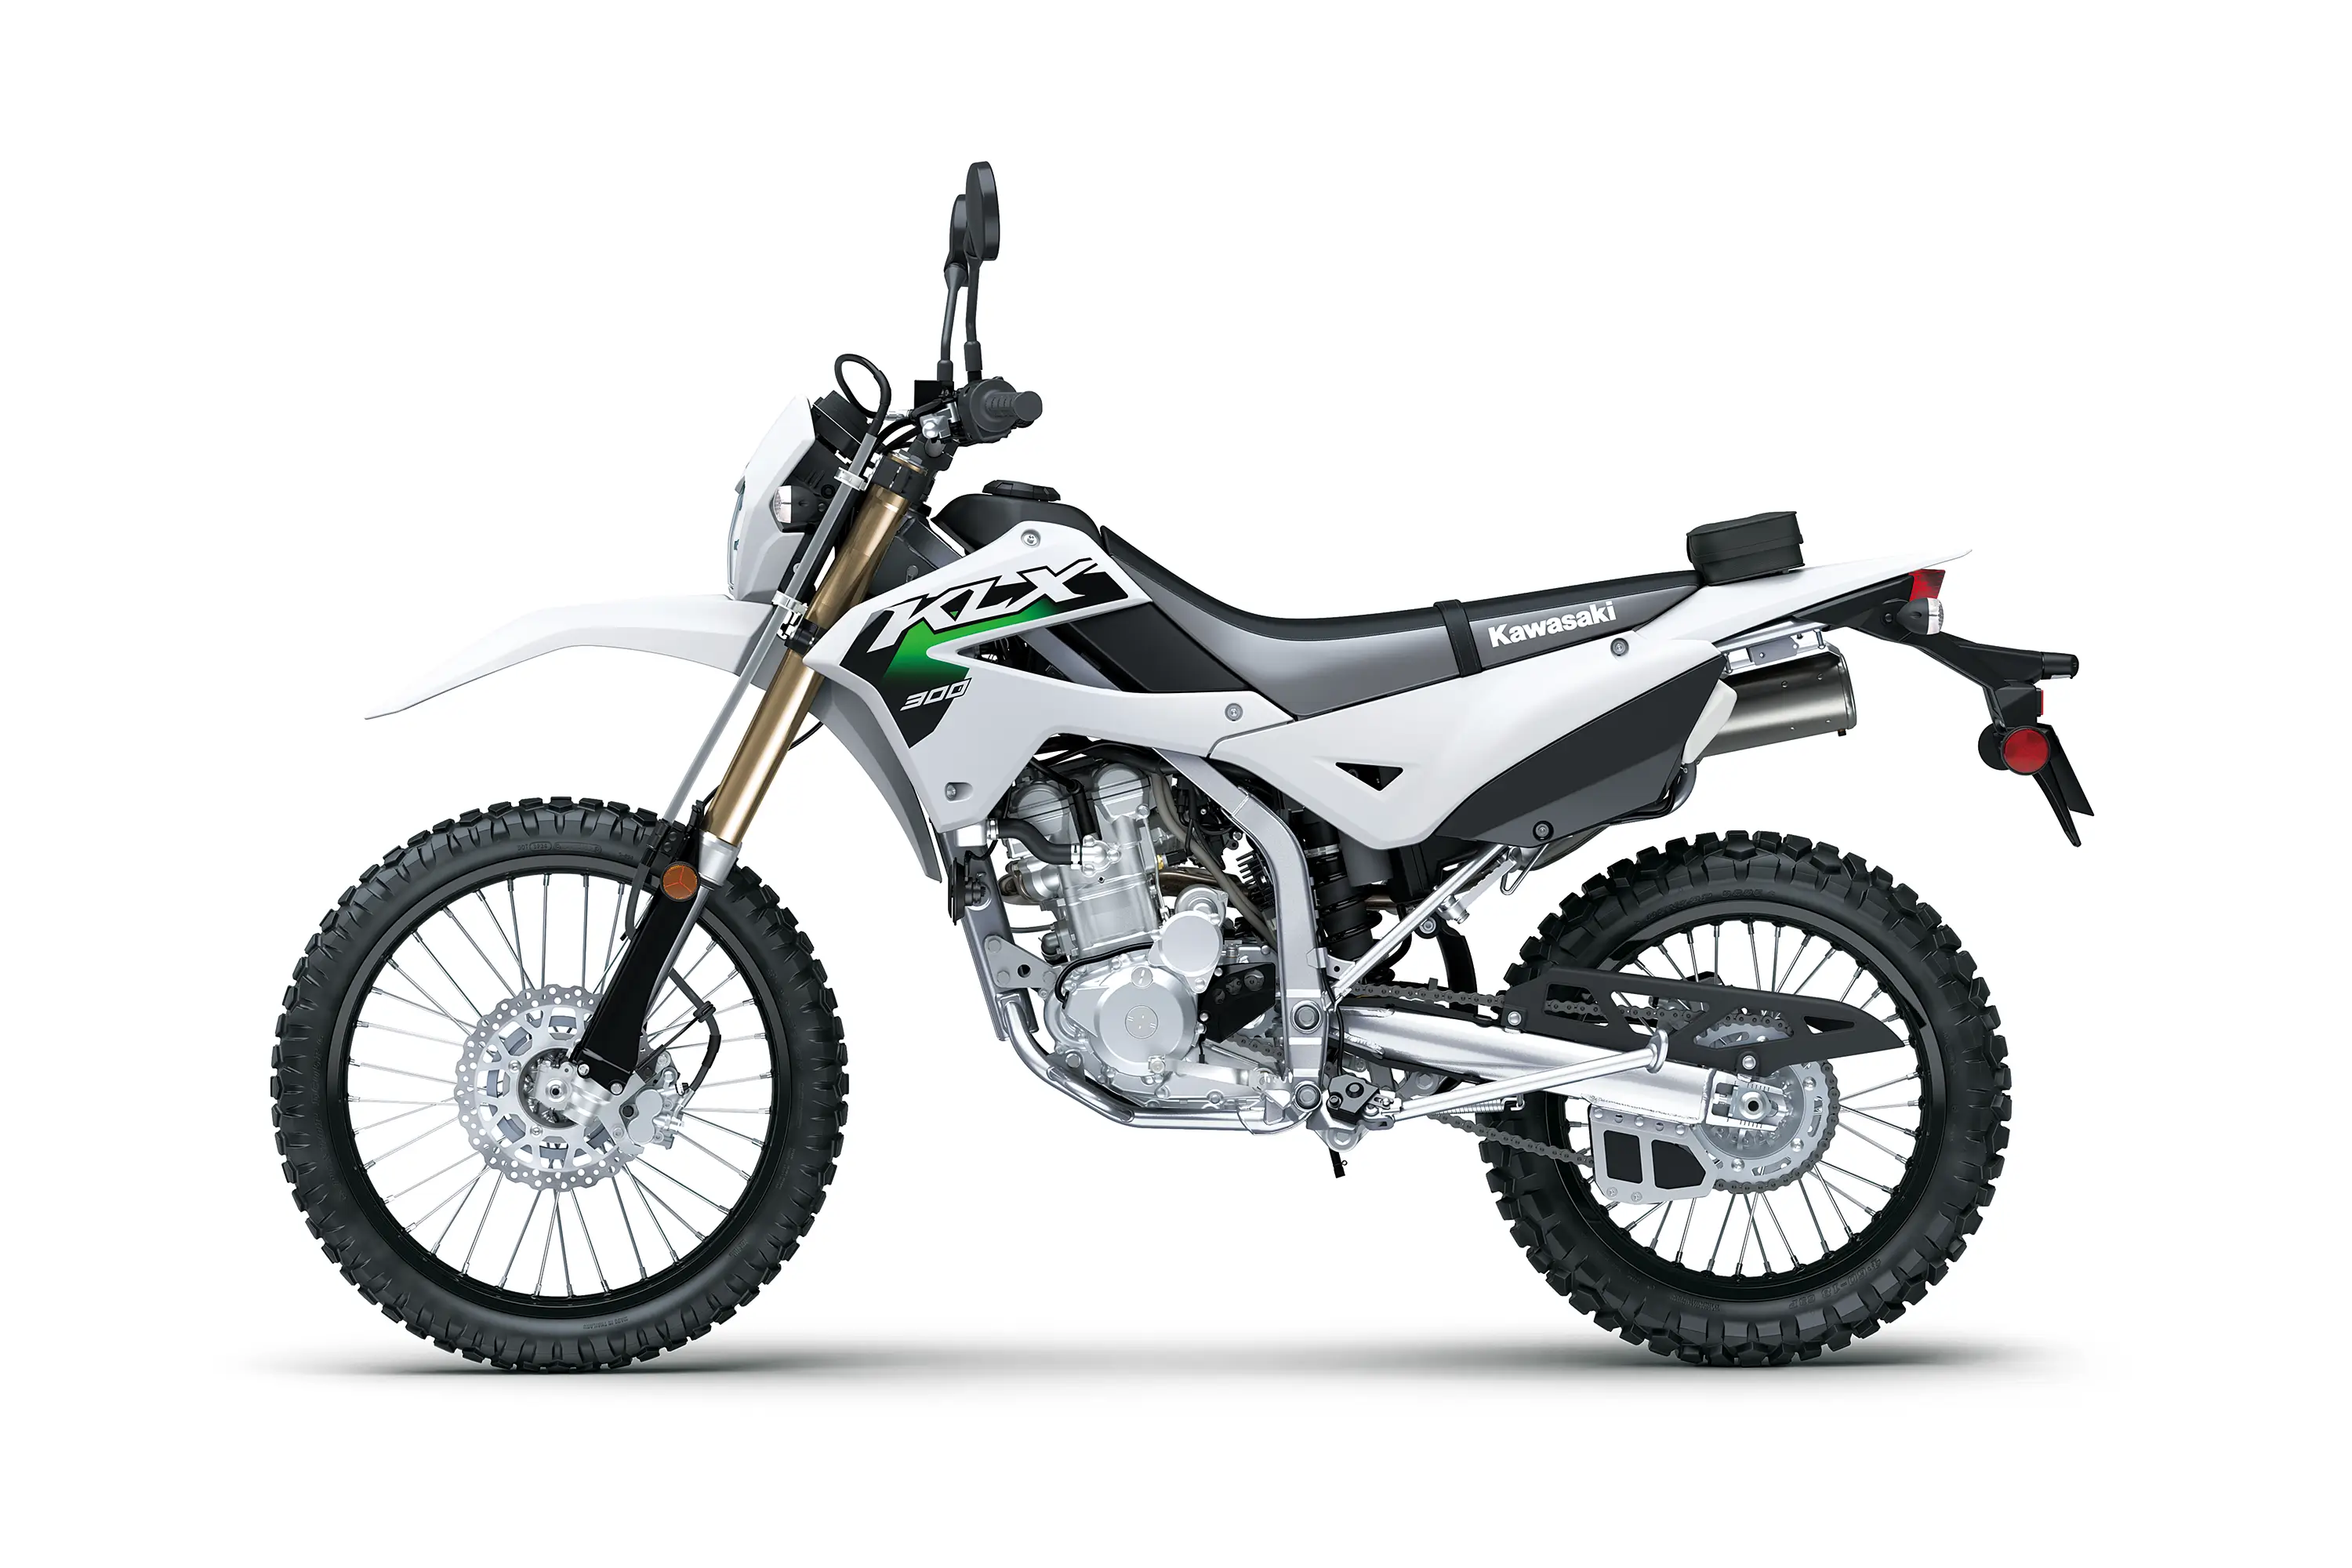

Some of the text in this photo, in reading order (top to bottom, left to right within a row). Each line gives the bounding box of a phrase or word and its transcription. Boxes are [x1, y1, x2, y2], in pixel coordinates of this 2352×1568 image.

[866, 557, 1098, 653] KLX
[1487, 600, 1617, 648] Kawasaki
[899, 677, 972, 712] 300
